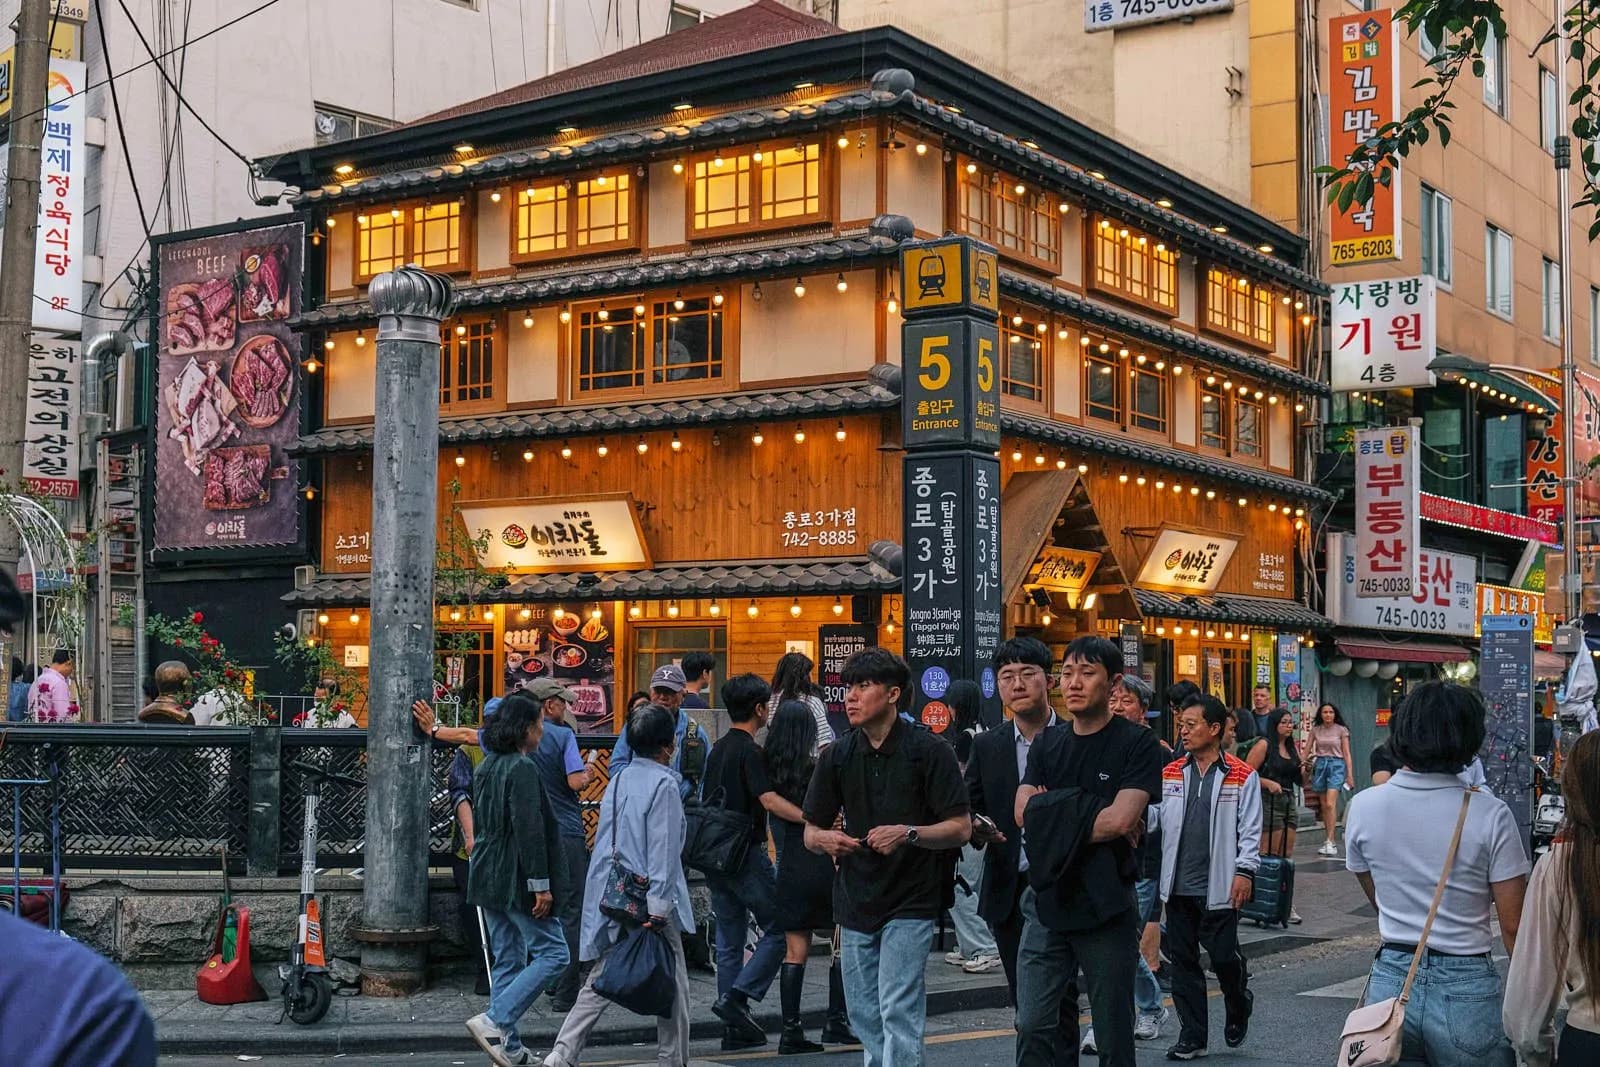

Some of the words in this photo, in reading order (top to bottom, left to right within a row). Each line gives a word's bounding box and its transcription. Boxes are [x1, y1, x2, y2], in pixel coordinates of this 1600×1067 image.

[1090, 2, 1113, 22] 1층
[46, 121, 71, 276] 백제정육식당
[1333, 239, 1392, 260] 765-6203
[197, 255, 227, 275] BEEF
[51, 297, 69, 310] 2F
[1338, 278, 1423, 310] 사랑방
[1338, 313, 1422, 355] 기원
[918, 335, 951, 390] 5
[977, 338, 994, 393] 5
[1360, 363, 1397, 383] 4층
[916, 399, 954, 416] 출입구
[977, 400, 995, 417] 출입구
[912, 419, 959, 430] Entrance
[975, 418, 998, 432] Entrance
[1360, 440, 1383, 455] 종로
[1391, 435, 1406, 455] 탑
[782, 507, 856, 529] 종로3가점
[1366, 464, 1407, 572] 부동산
[1536, 508, 1554, 520] 2F
[334, 531, 370, 549] 소고기
[530, 520, 608, 556] 이차돌
[781, 530, 856, 547] 742-8885
[911, 467, 938, 599] 종로3가
[940, 491, 957, 584] (탑골공원)
[975, 469, 989, 600] 종로3가
[989, 497, 998, 588] (탑골공원)
[1181, 551, 1218, 583] 이차돌
[1360, 577, 1410, 592] 745-0033
[909, 608, 931, 622] Jongno
[932, 607, 961, 622] 3(sam)-ga
[1376, 606, 1447, 630] 745-0033
[911, 622, 940, 632] (Tapgol
[941, 622, 960, 631] Park)
[916, 634, 955, 645] 钟路三街
[824, 643, 852, 657] 마성의
[662, 670, 673, 680] Y
[928, 672, 943, 680] 130
[925, 681, 947, 692] 1호선
[929, 705, 943, 714] 329
[1350, 1040, 1365, 1056] NIKE
